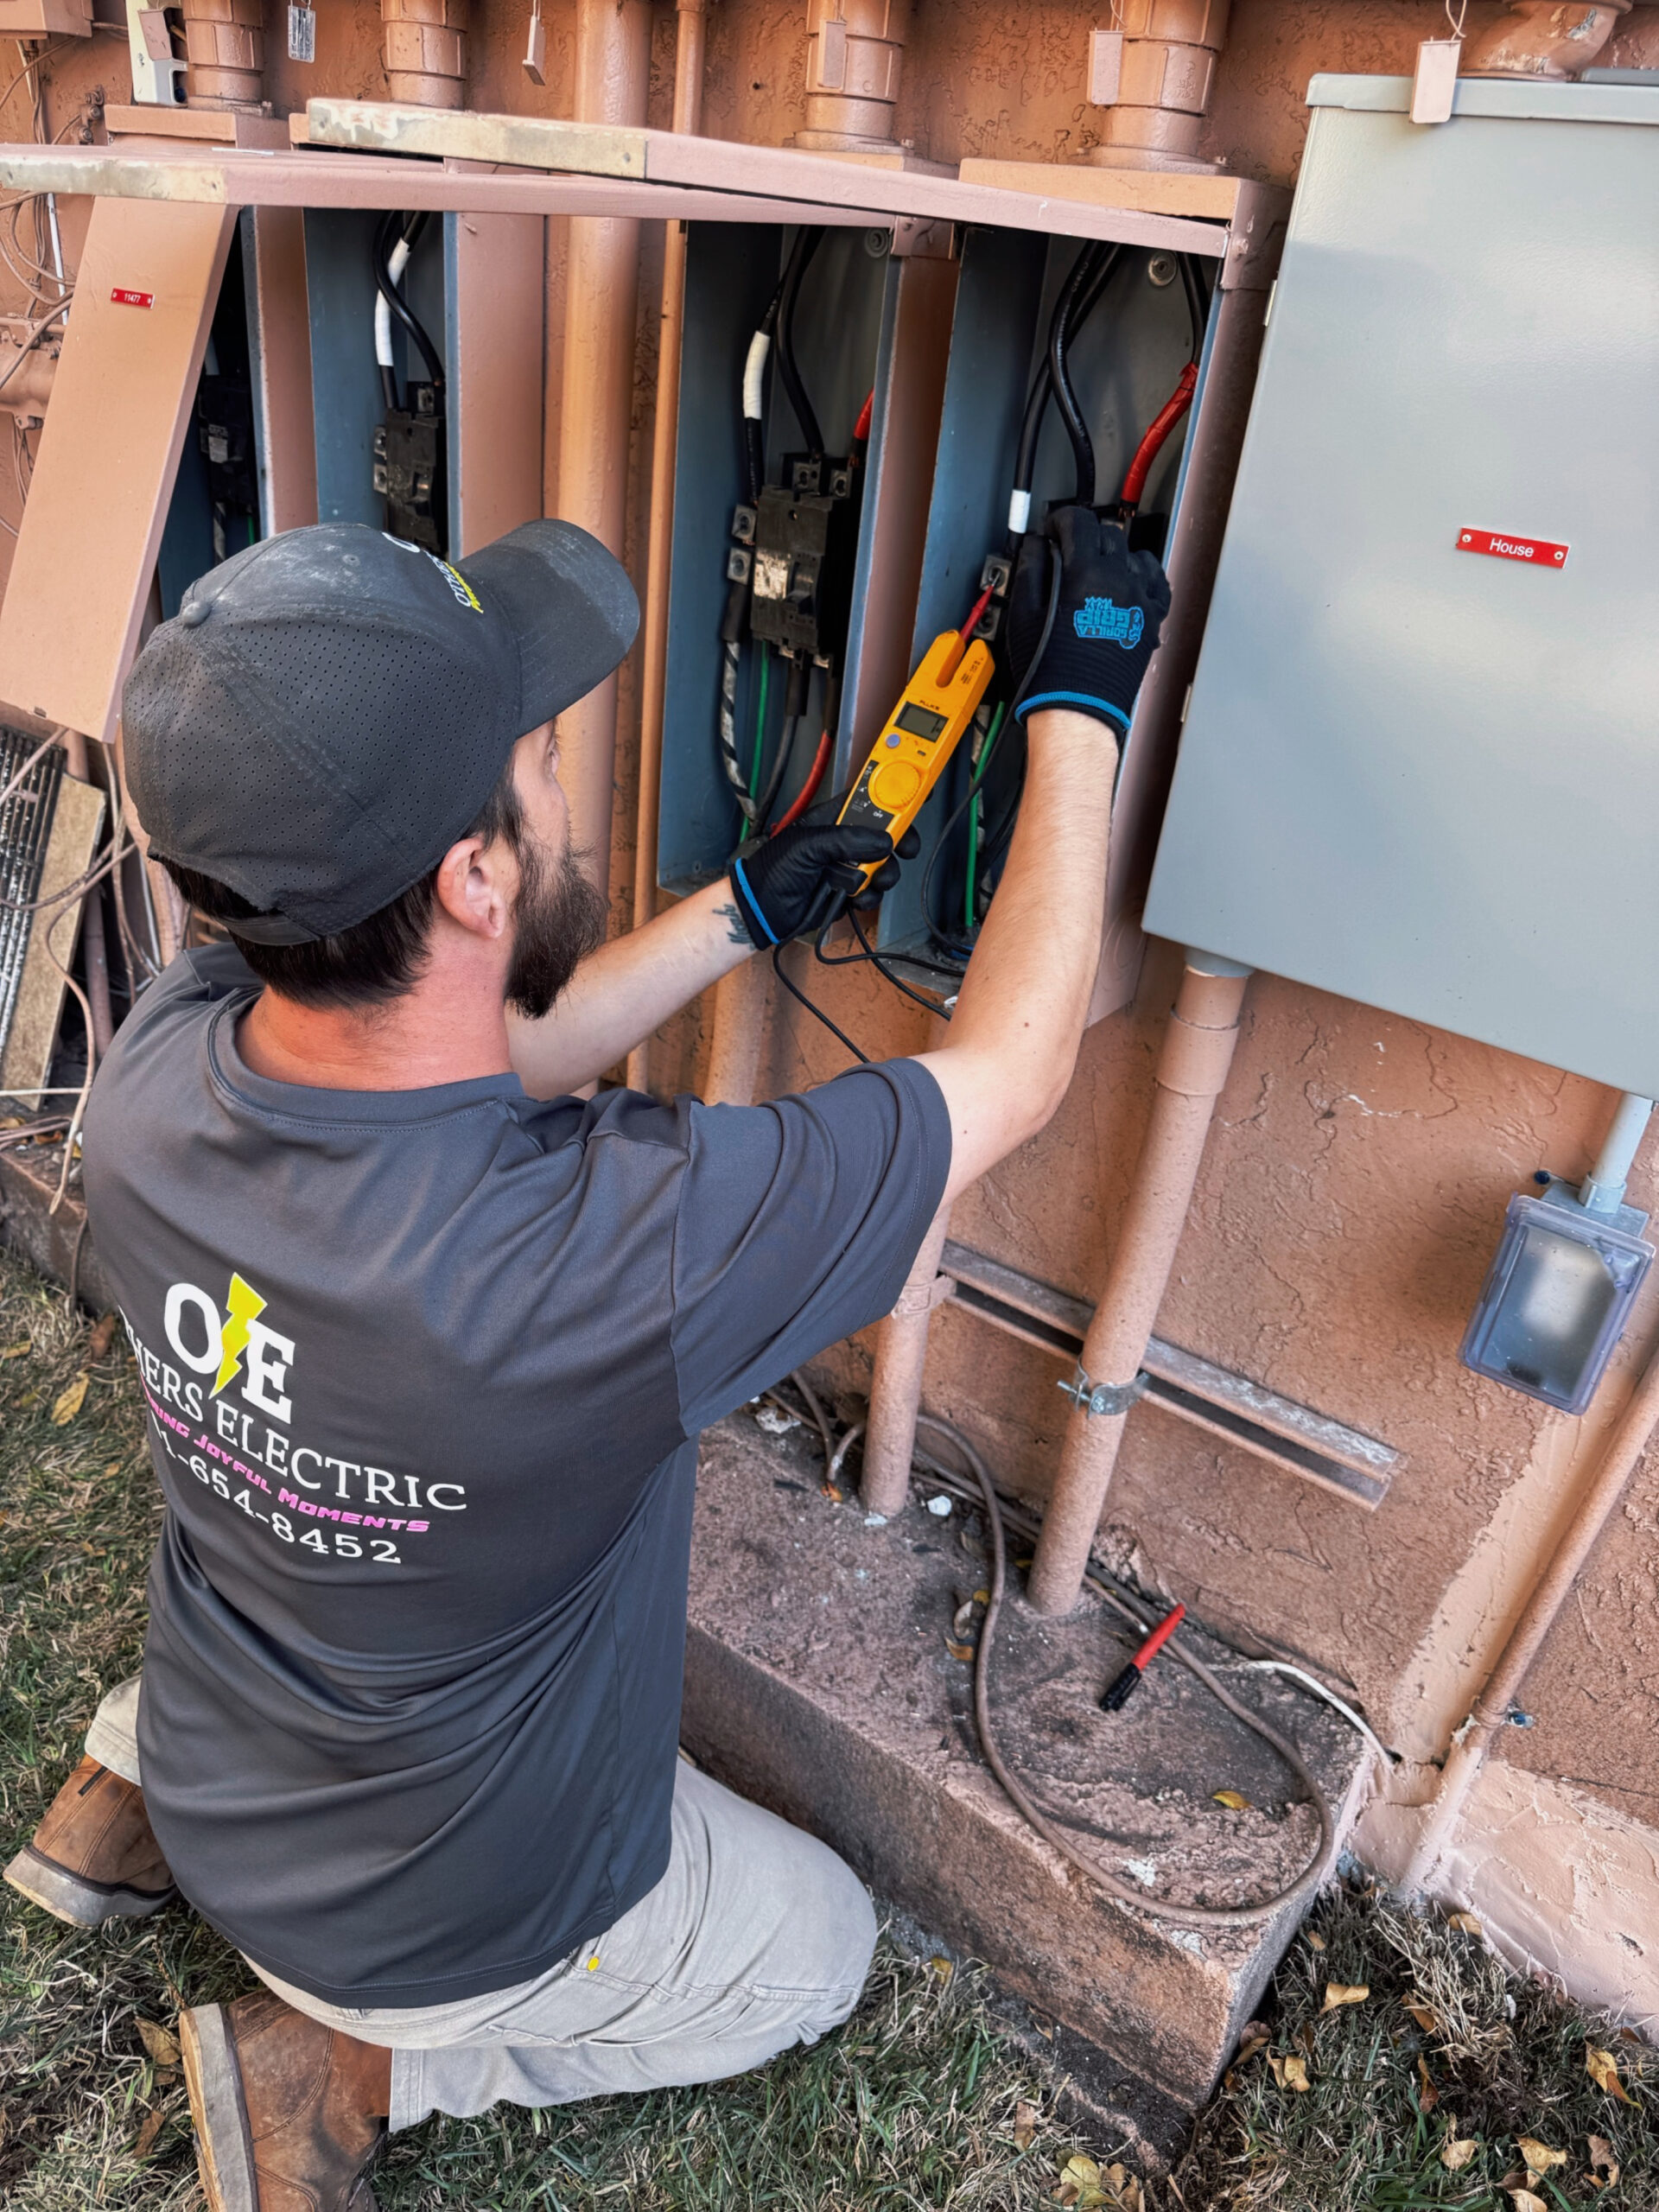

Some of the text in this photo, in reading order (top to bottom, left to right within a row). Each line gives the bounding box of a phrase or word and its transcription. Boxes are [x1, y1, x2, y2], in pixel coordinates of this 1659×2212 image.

[1489, 537, 1535, 558] House
[1077, 608, 1130, 629] GRIP
[1077, 625, 1128, 639] GORILLA
[193, 1433, 271, 1495] JOYFUL
[277, 1487, 430, 1533] MOMENTS
[215, 1399, 467, 1511] ELECTRIC
[150, 1409, 402, 1565] 1-654-8452
